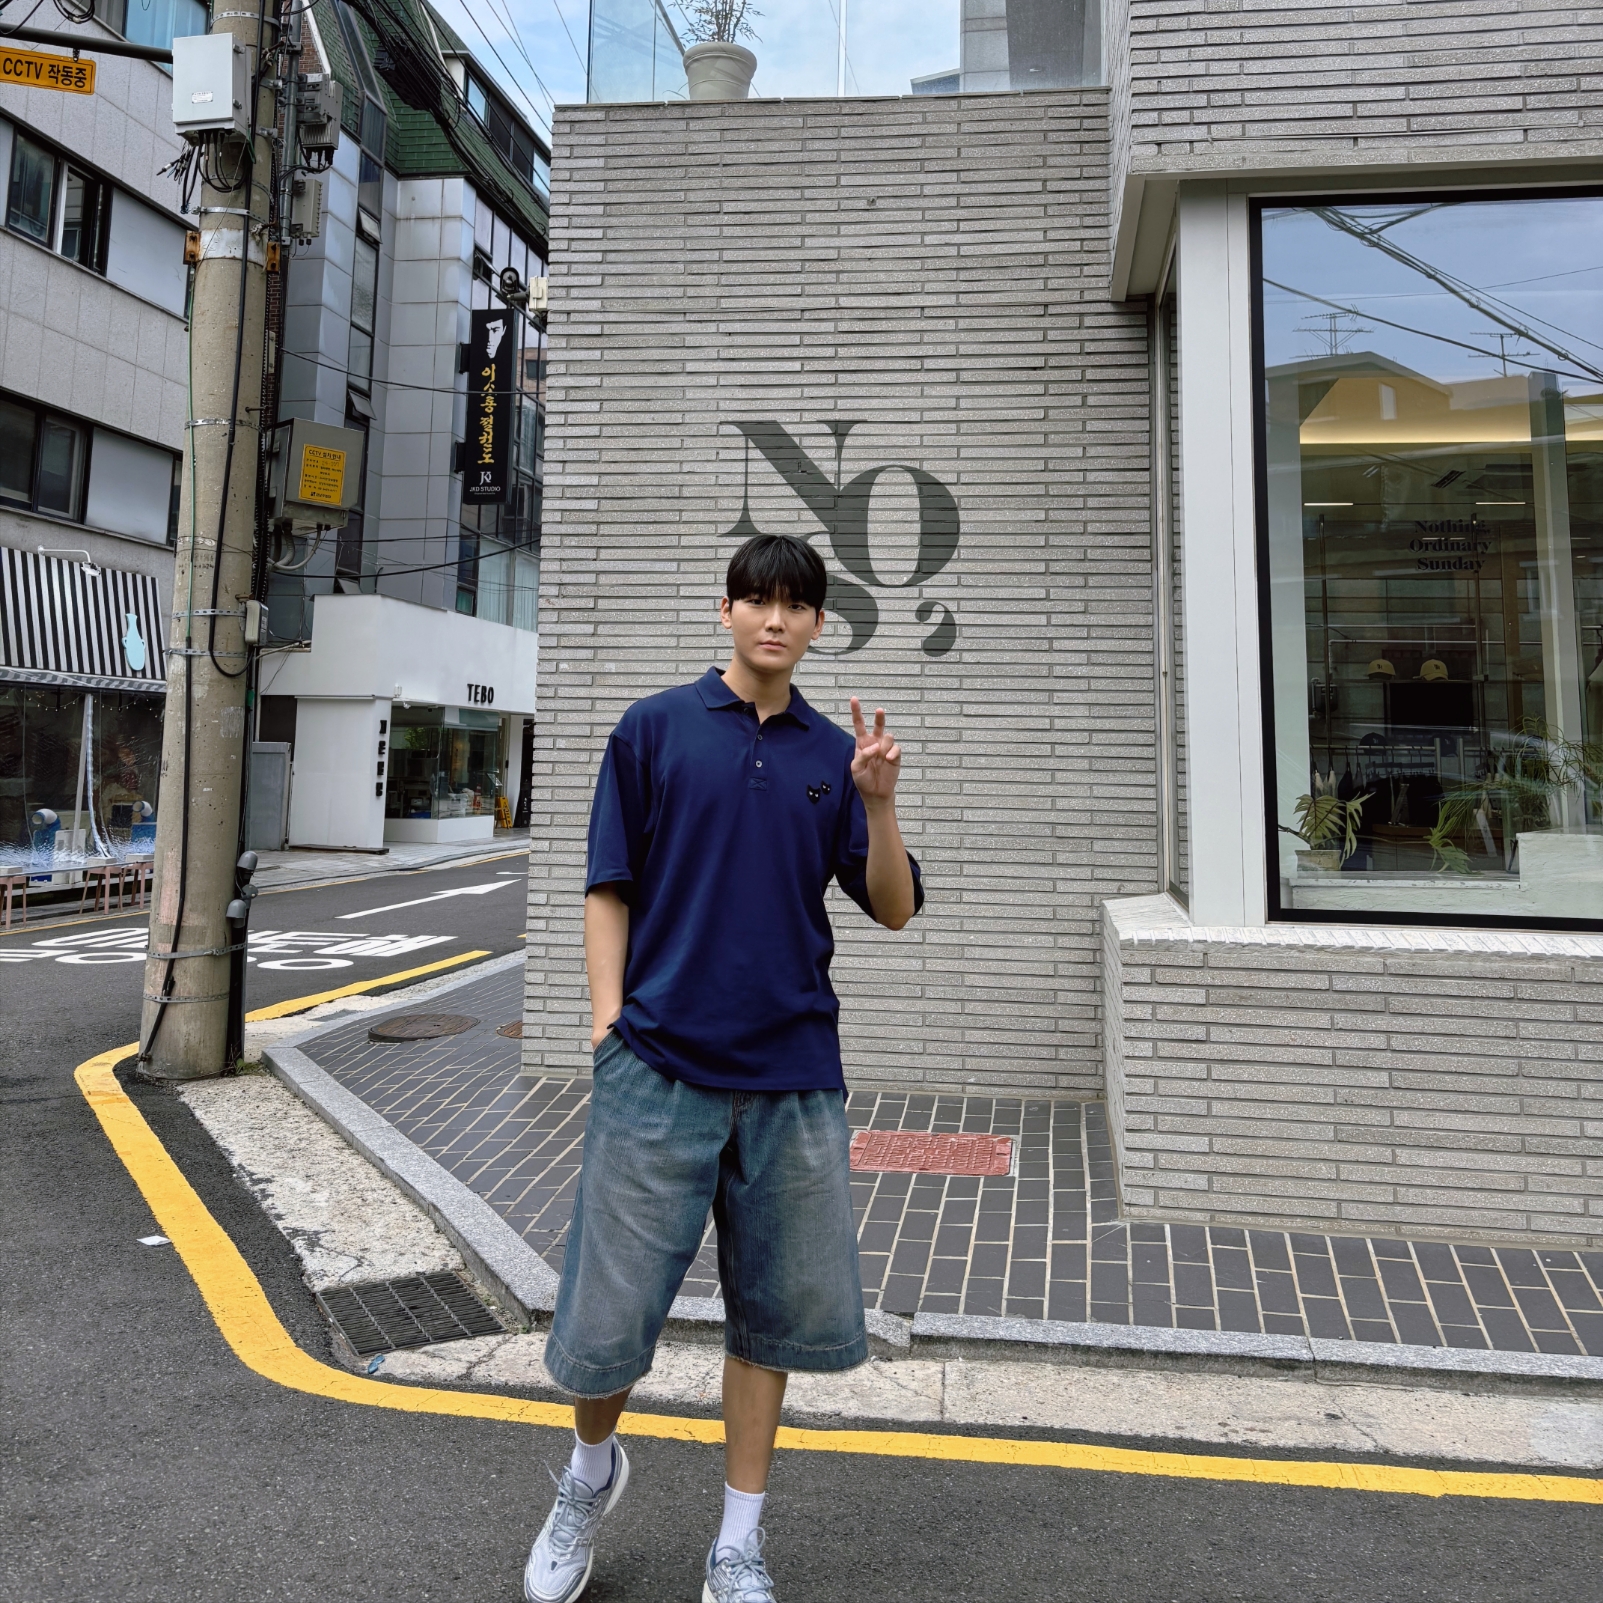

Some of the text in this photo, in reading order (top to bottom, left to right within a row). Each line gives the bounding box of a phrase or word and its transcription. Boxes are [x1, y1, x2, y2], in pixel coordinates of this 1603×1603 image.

[3, 57, 87, 88] CCTV 작동중
[1409, 537, 1492, 555] Ordinary
[1417, 556, 1486, 574] Sunday
[467, 683, 495, 704] TEBO
